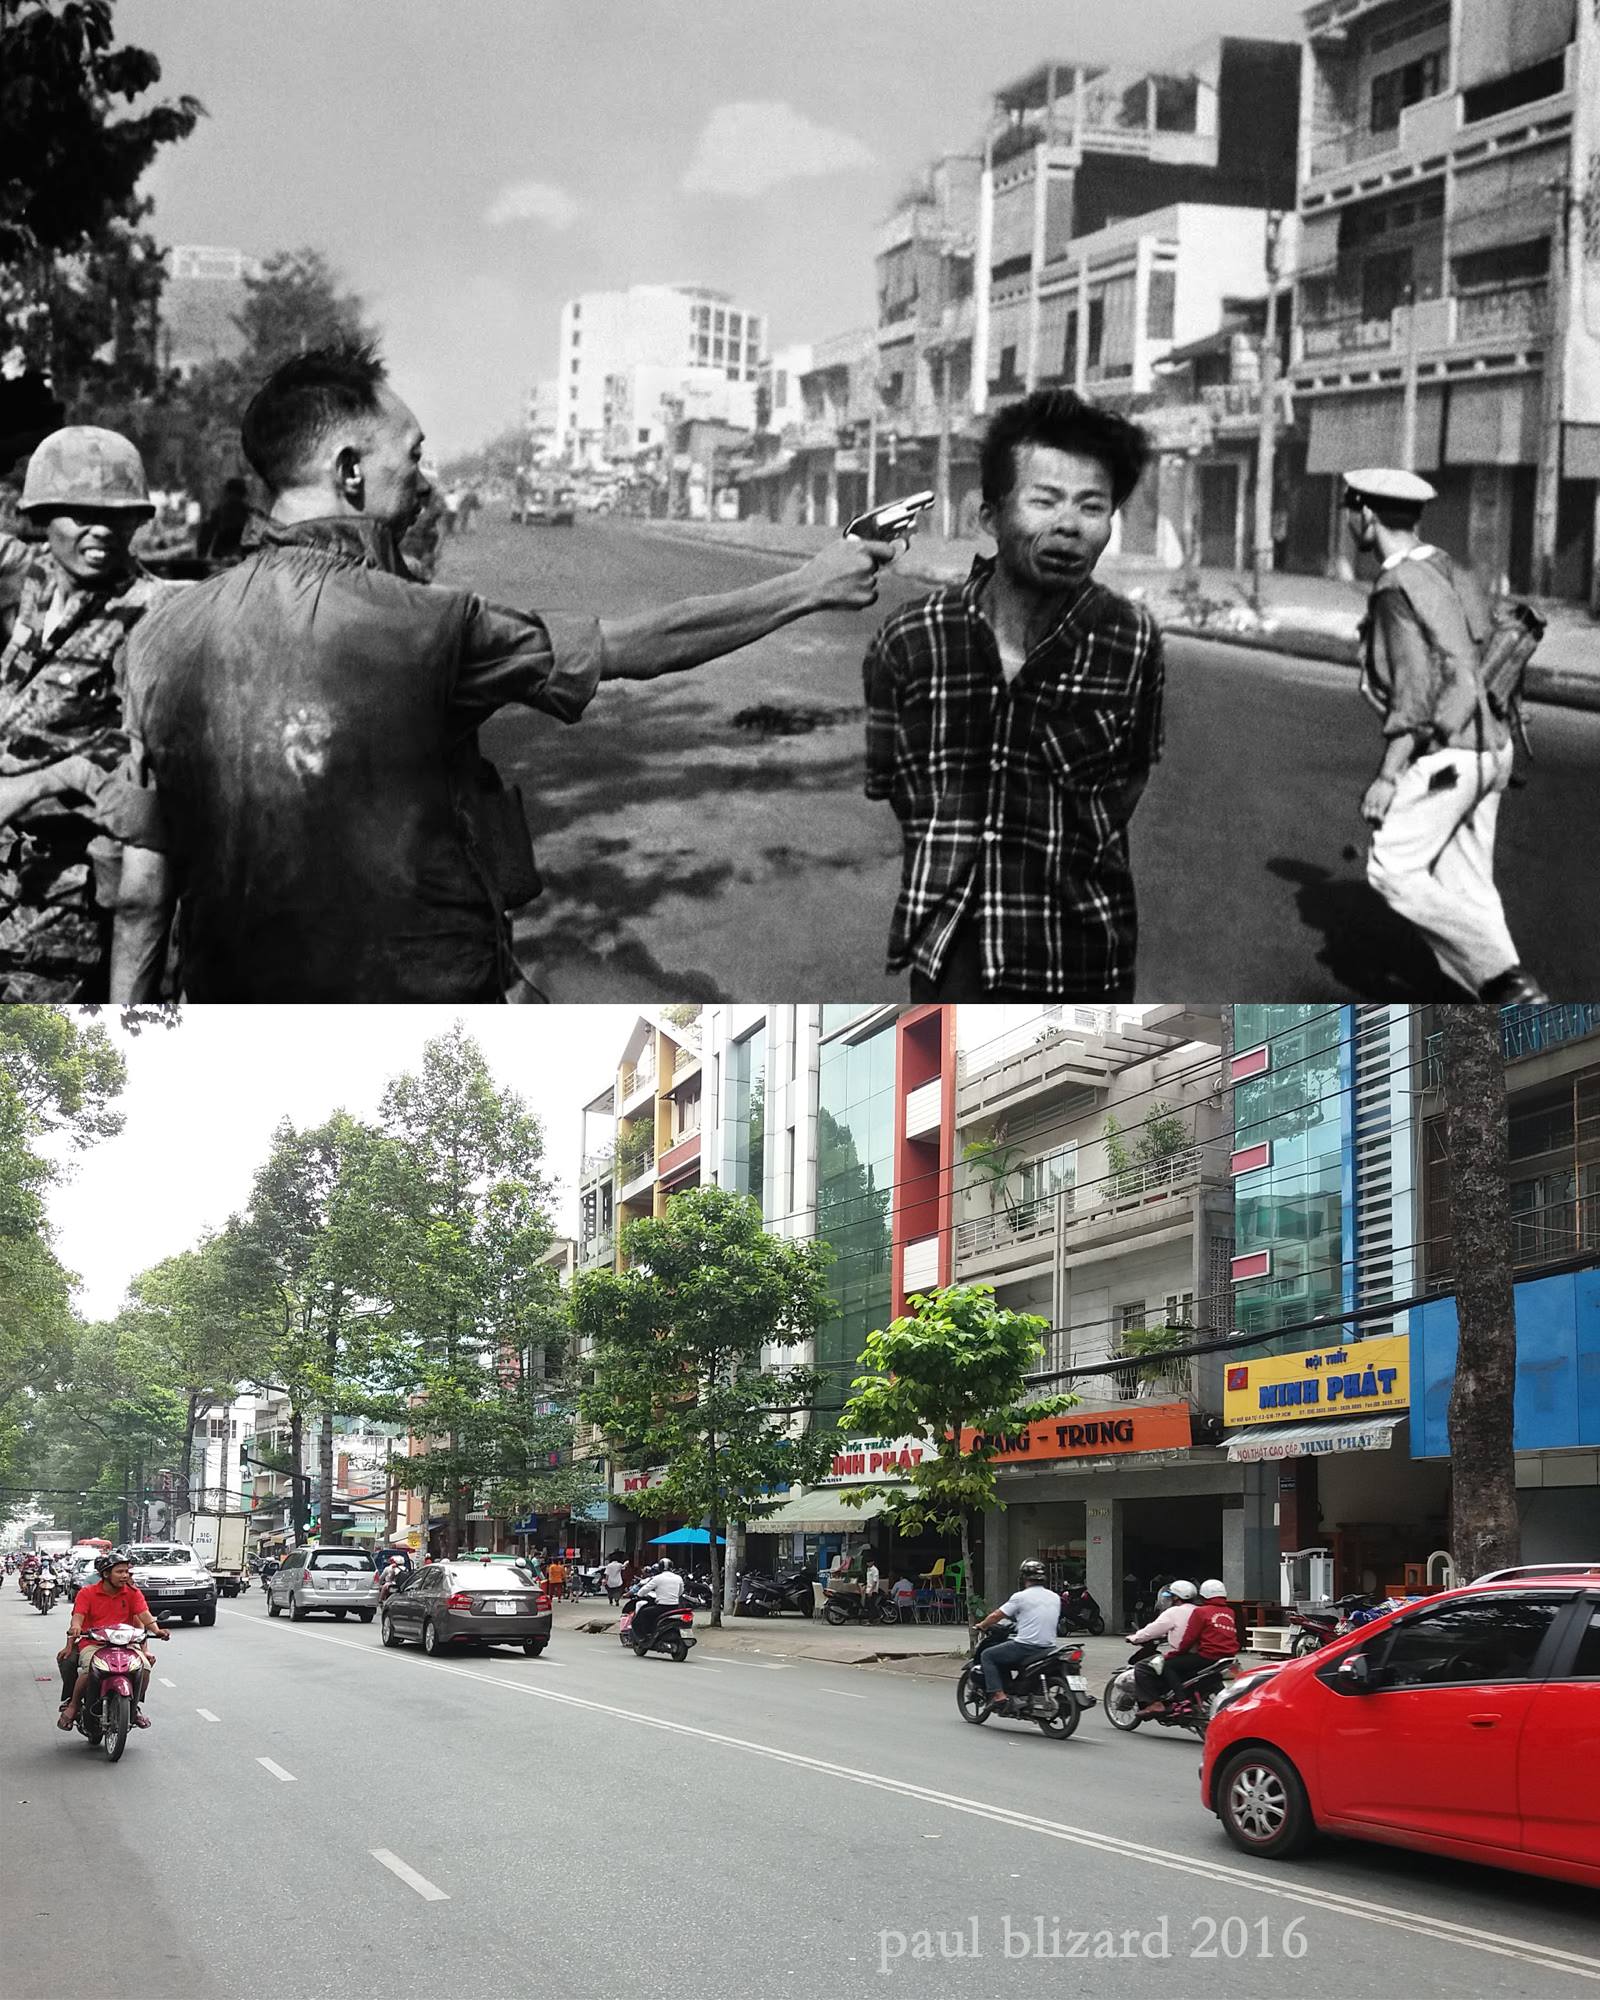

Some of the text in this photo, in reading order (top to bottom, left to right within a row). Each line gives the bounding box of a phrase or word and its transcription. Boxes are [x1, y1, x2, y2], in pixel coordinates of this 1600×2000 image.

[1259, 1363, 1397, 1409] MINH PHÁT
[1055, 1419, 1134, 1448] TRUNG
[832, 1442, 924, 1476] INH PHÁT
[1268, 1445, 1284, 1456] CAO
